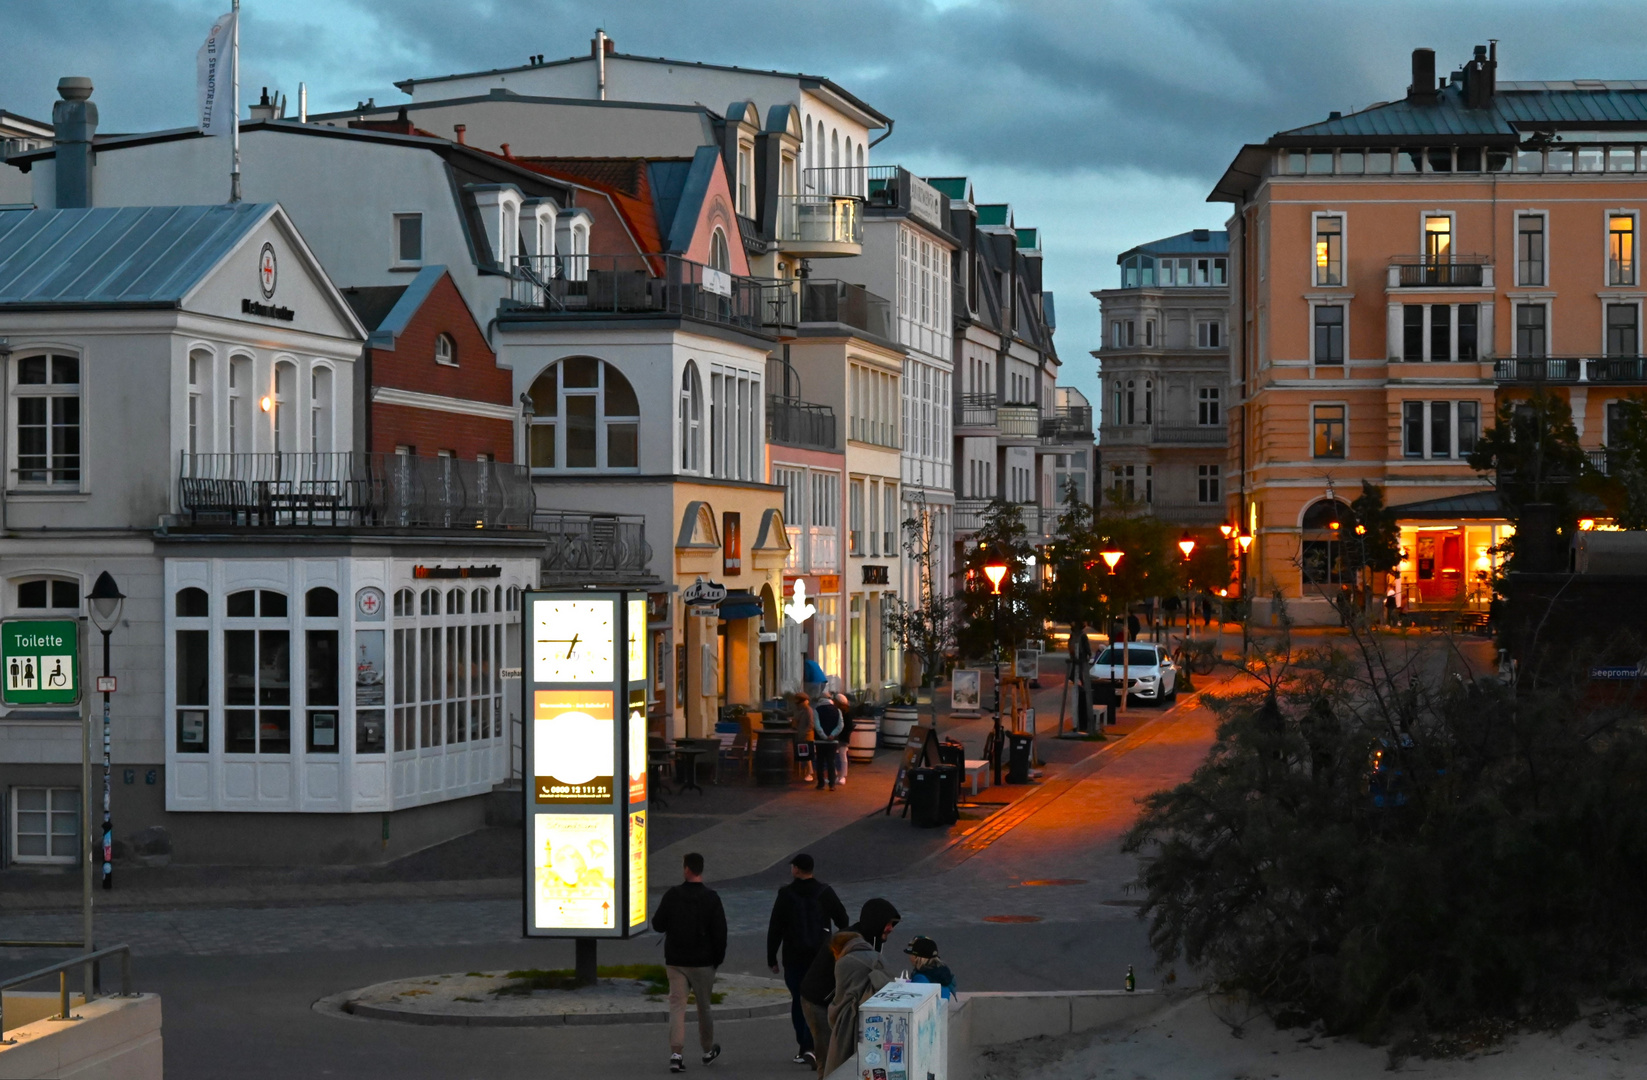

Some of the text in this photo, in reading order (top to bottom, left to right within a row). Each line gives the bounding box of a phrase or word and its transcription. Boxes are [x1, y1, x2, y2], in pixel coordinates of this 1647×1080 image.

[202, 37, 217, 129] DIE SEENOTRETTER
[14, 635, 63, 646] Toilette
